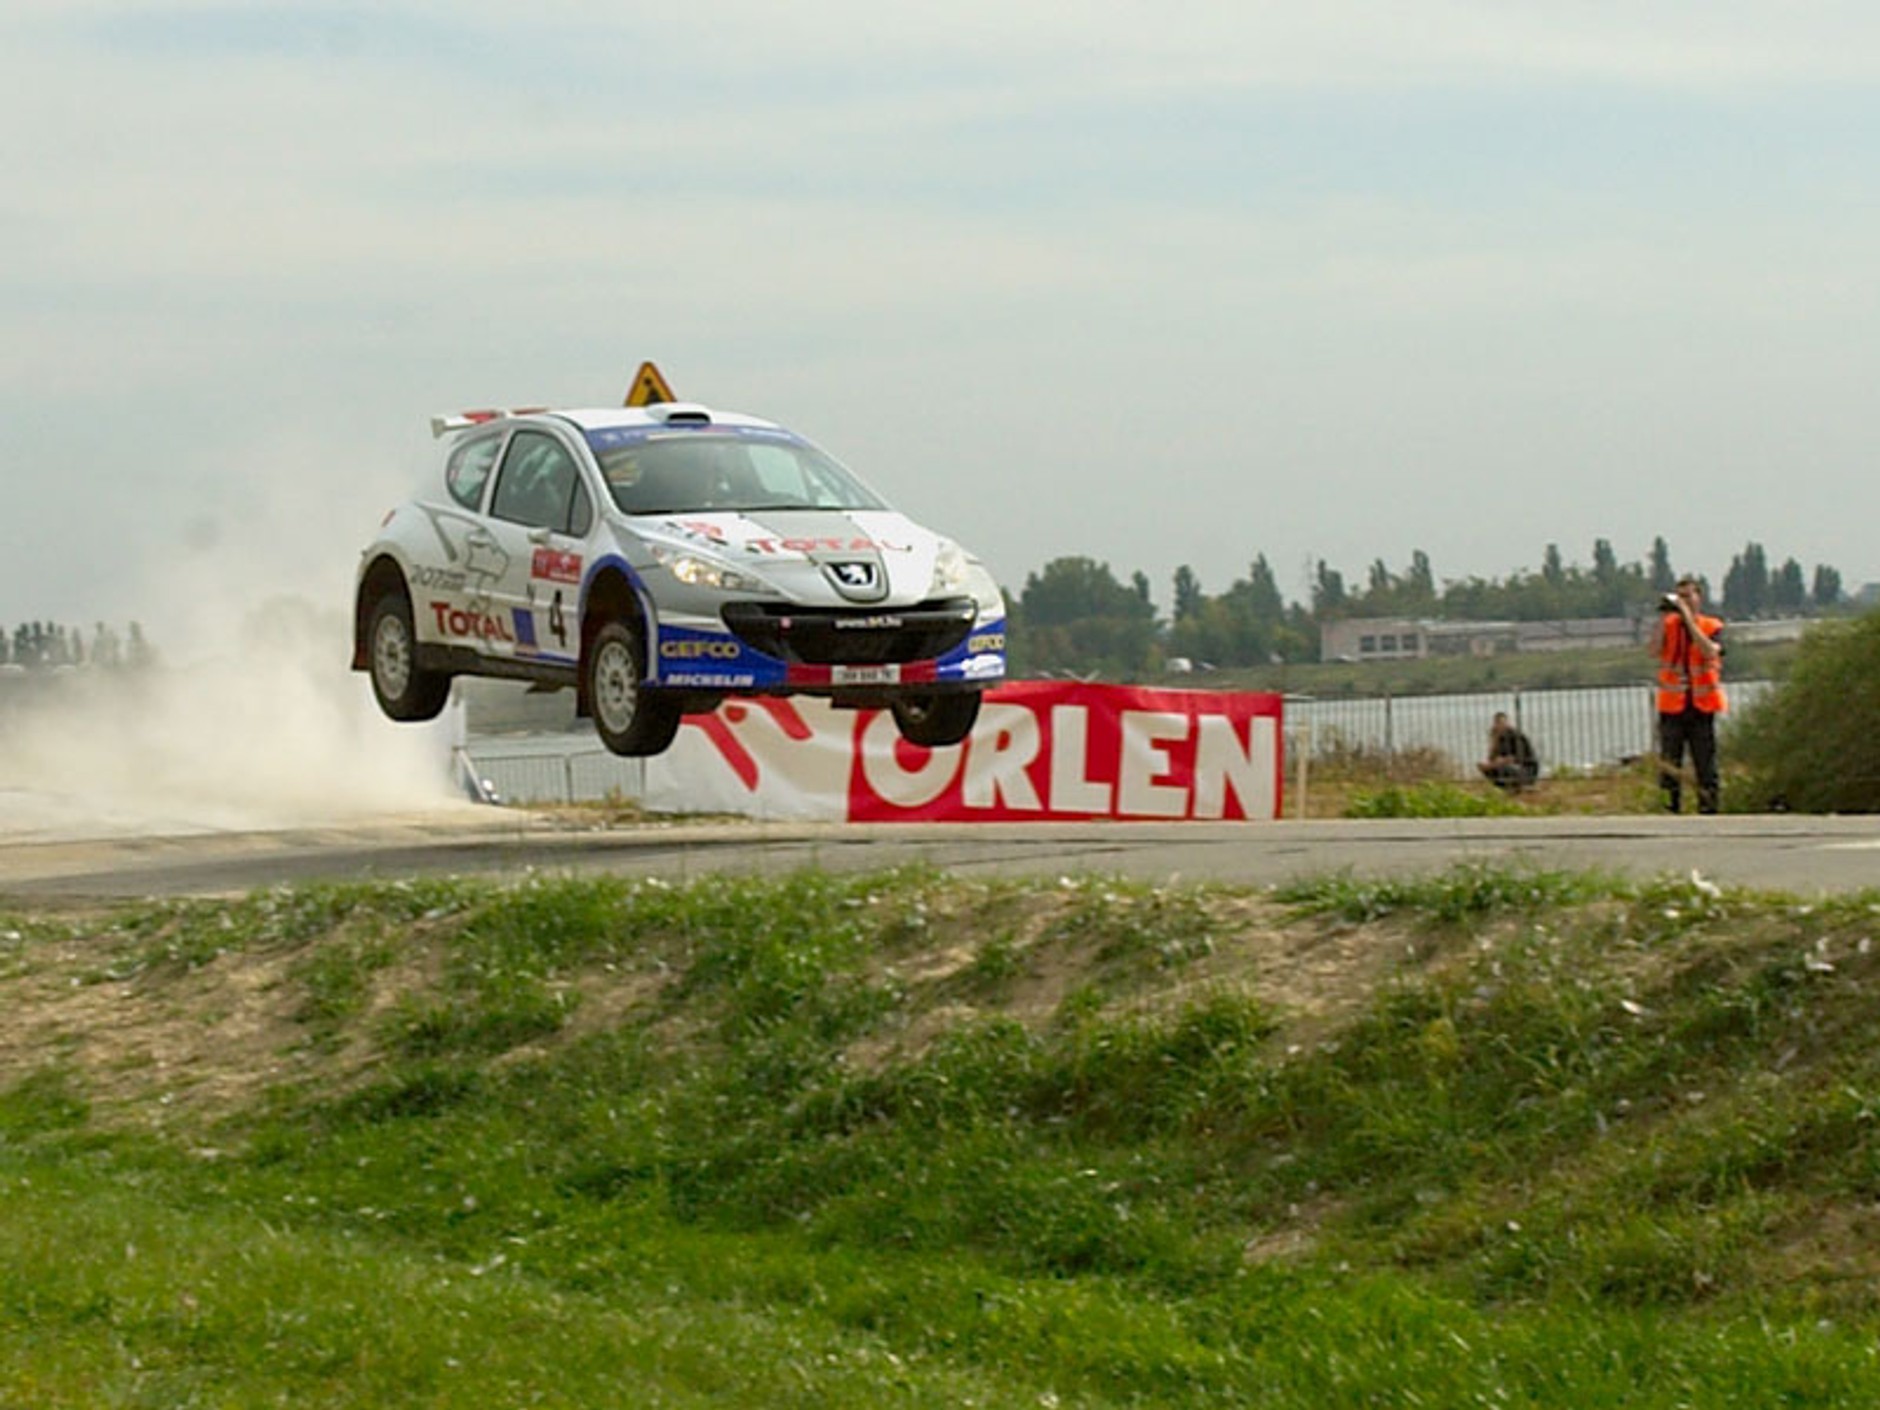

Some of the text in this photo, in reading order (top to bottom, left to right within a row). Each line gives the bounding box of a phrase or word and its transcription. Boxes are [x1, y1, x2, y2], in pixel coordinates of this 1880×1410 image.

[746, 537, 910, 553] TOTAL
[430, 601, 513, 642] TOTAL
[549, 589, 566, 647] 4
[660, 640, 740, 659] GEFCO
[666, 673, 753, 687] MICHELIN
[861, 702, 1276, 820] ORLEN
